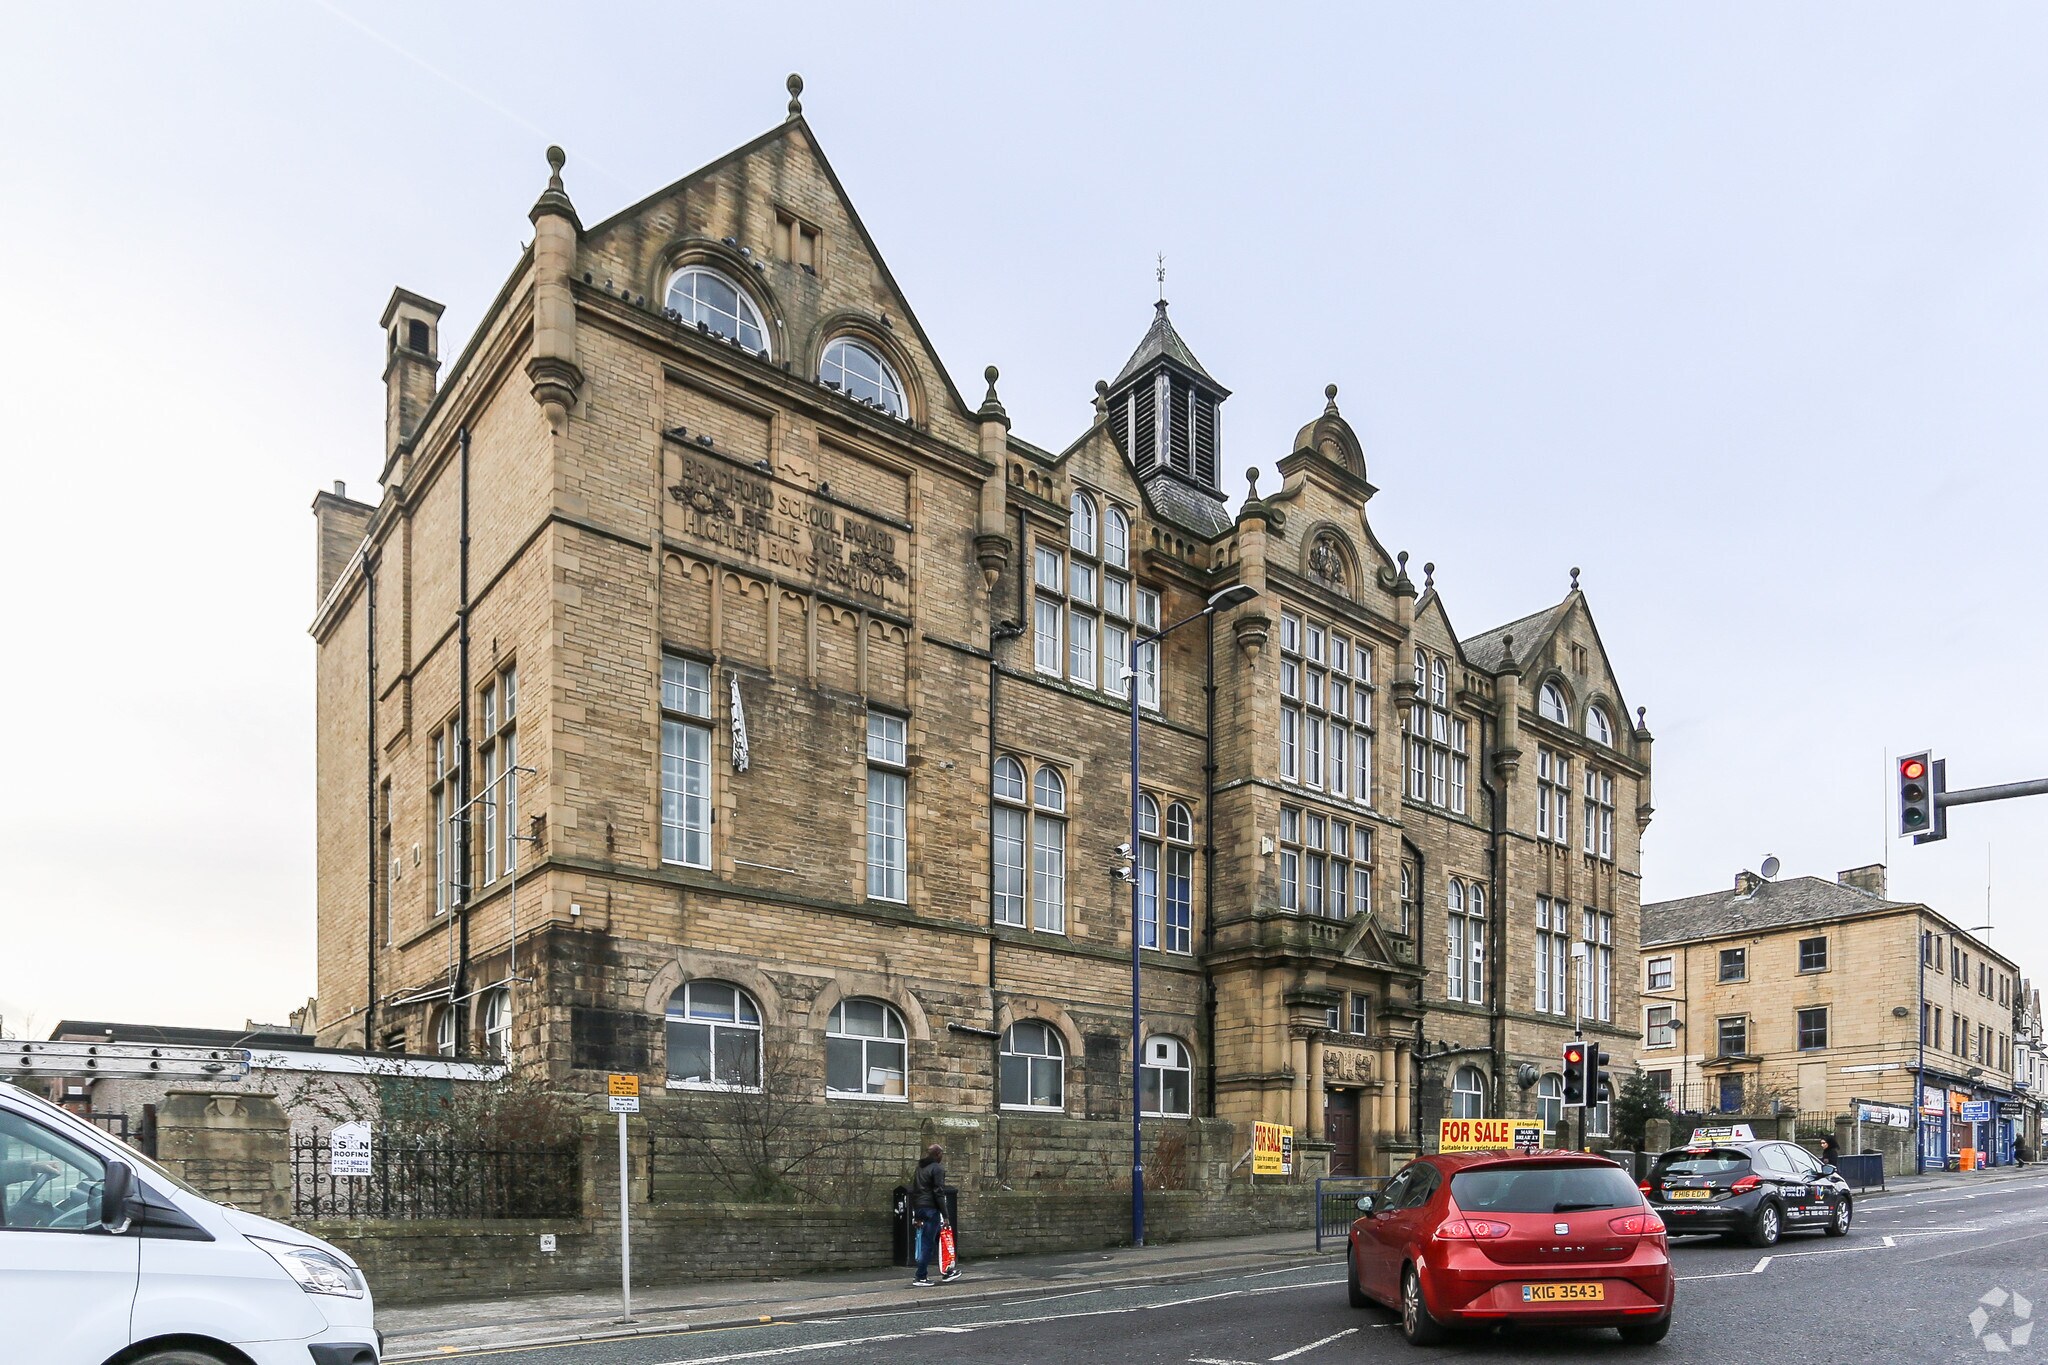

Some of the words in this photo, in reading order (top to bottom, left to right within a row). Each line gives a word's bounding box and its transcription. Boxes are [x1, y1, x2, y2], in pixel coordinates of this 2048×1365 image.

[682, 456, 775, 510] BRADFORD
[777, 494, 841, 541] SCHOOL
[843, 518, 896, 555] BOARD
[742, 508, 801, 544] BELLE
[809, 531, 844, 561] VUE
[684, 510, 760, 558] HIGHER
[768, 540, 820, 576] BOYS
[825, 561, 894, 602] SCHOOL
[1255, 1125, 1266, 1151] FOR
[1267, 1126, 1280, 1152] SALE
[1442, 1122, 1469, 1142] FOR
[1474, 1122, 1509, 1142] SALE
[338, 1140, 369, 1150] SKN
[1674, 1190, 1690, 1199] FH16
[1532, 1286, 1555, 1299] KIG
[1560, 1285, 1597, 1298] 3543
